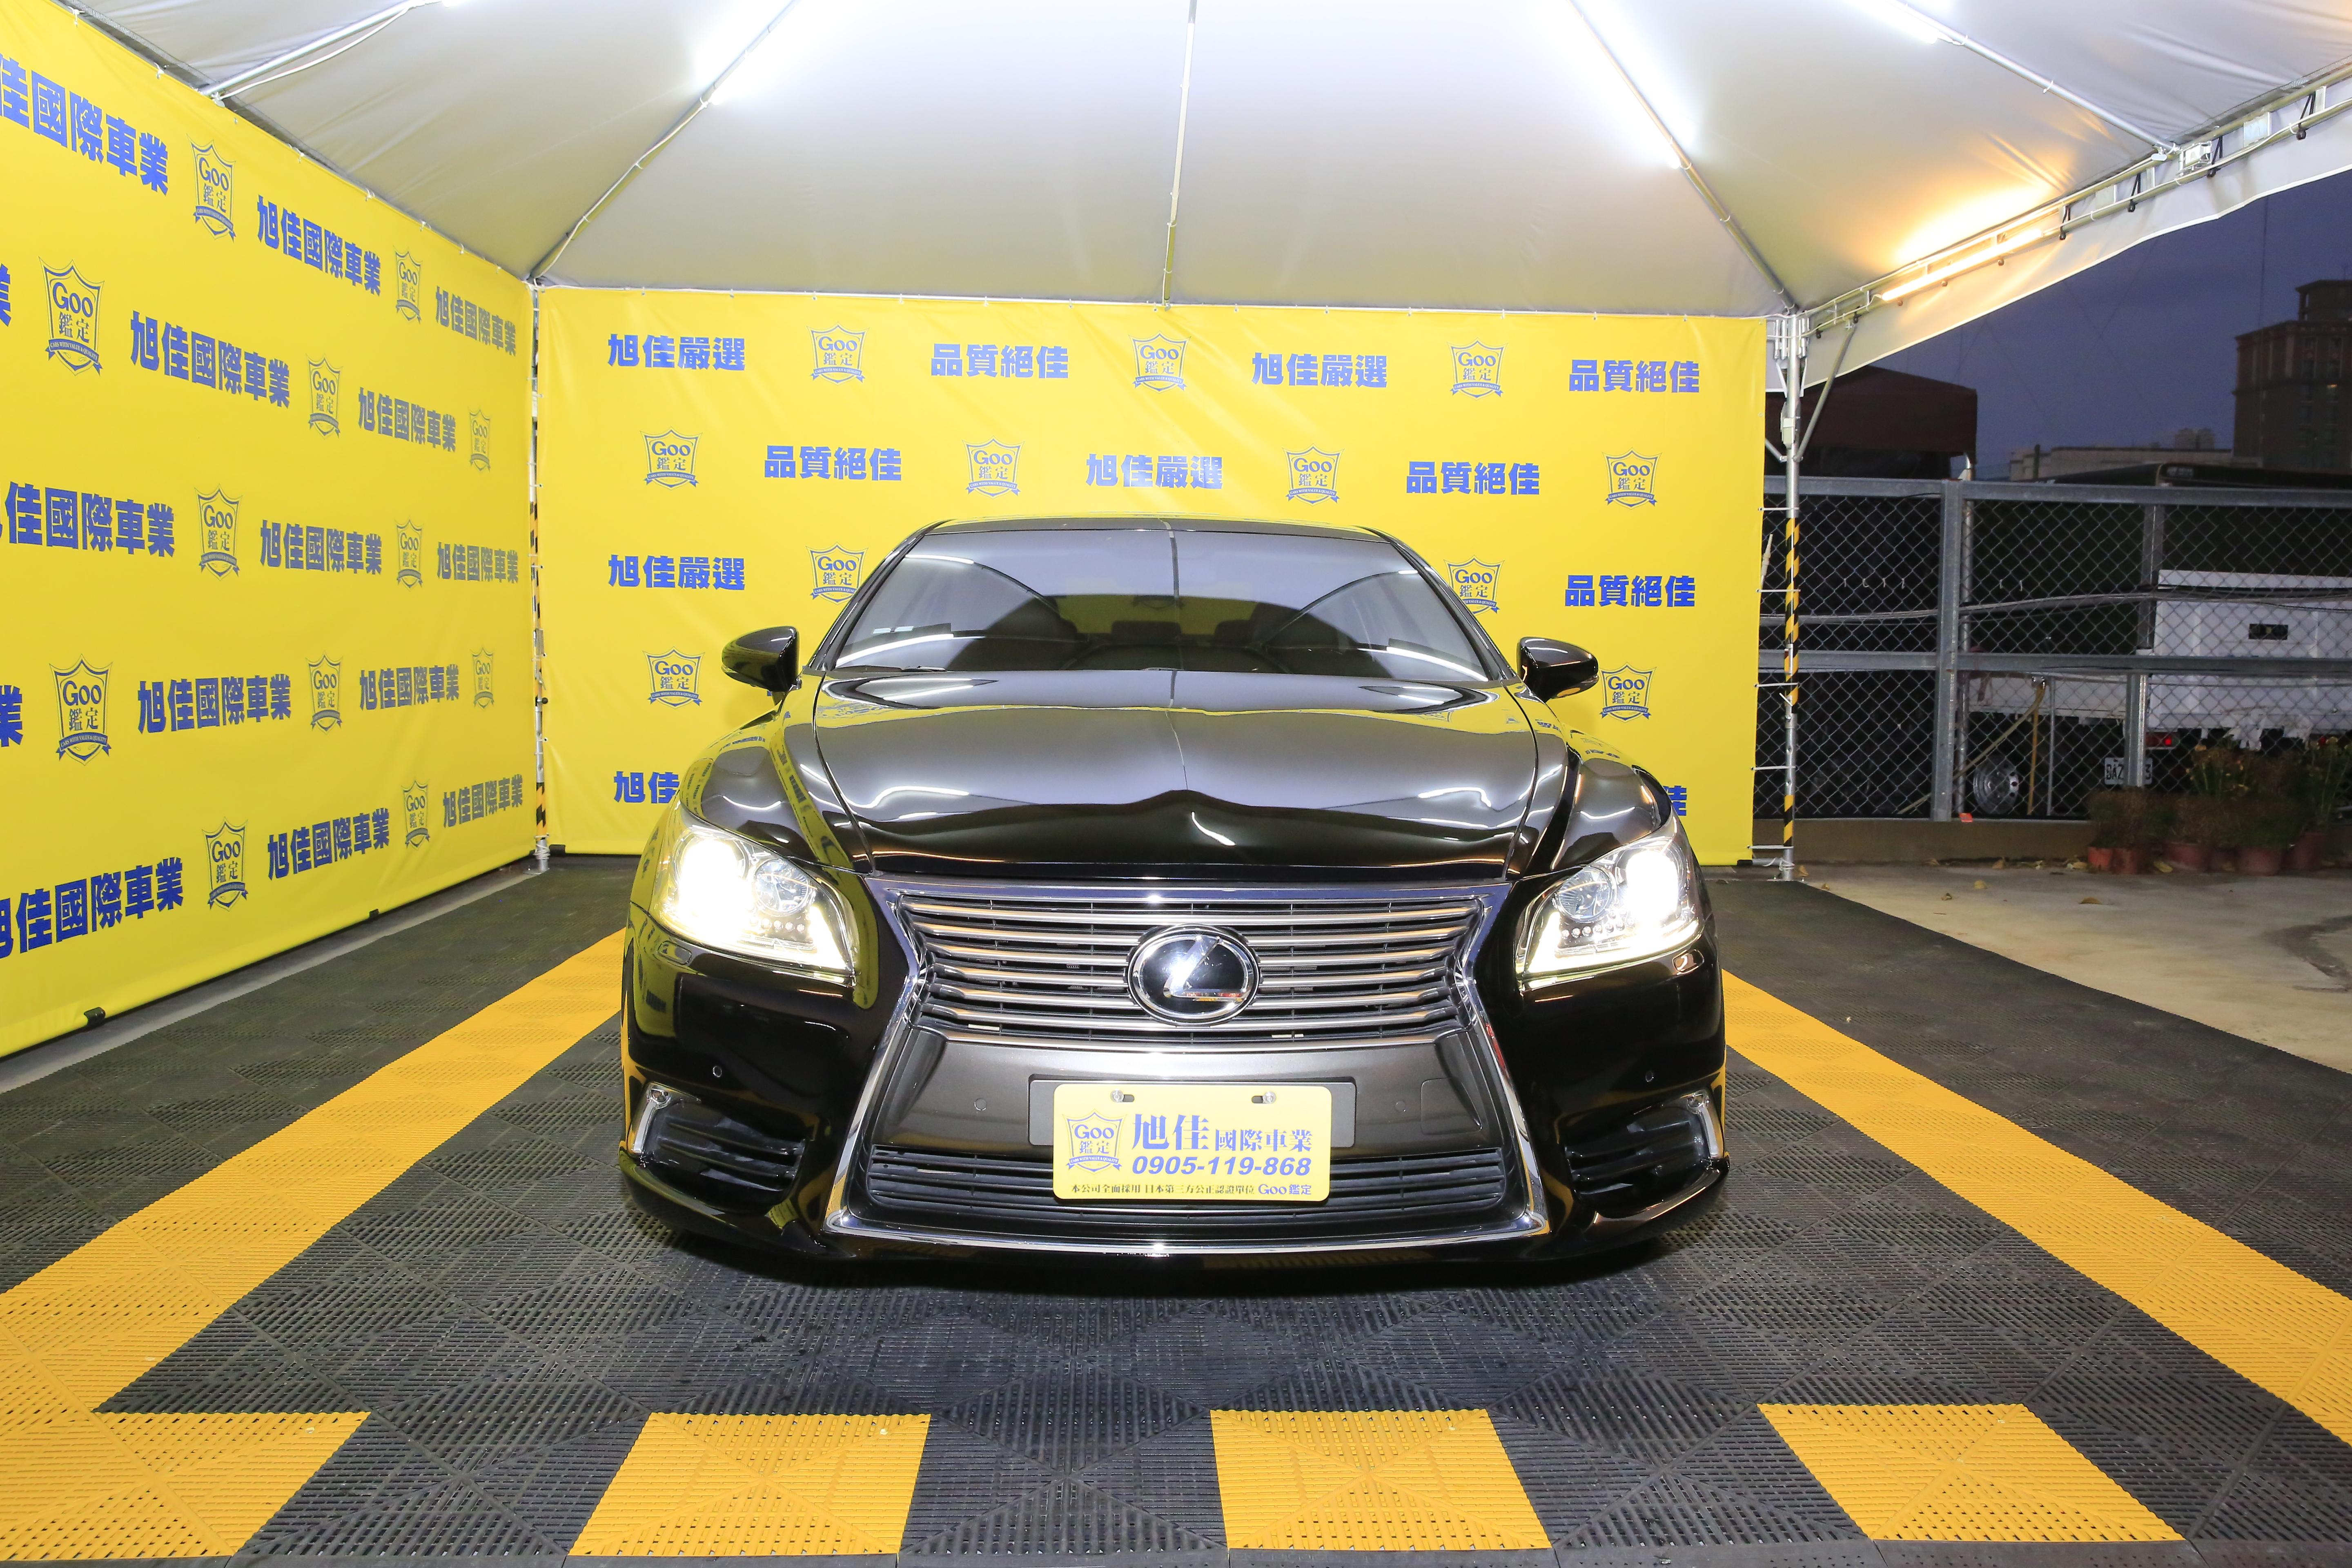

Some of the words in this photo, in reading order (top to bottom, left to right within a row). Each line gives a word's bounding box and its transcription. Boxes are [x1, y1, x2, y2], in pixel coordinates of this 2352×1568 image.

[199, 157, 229, 191] Goo
[203, 183, 226, 212] 鑑定
[257, 195, 381, 296] 旭佳國際車業
[399, 261, 418, 285] Goo
[53, 282, 94, 318] Goo
[58, 312, 89, 343] 鑑定
[436, 286, 517, 356] 旭佳國際車業
[608, 334, 745, 371] 旭佳嚴選
[818, 336, 858, 351] Goo
[1140, 345, 1179, 360] Goo
[131, 310, 290, 408] 旭佳國際車業
[824, 352, 853, 366] 鑑定
[931, 343, 1069, 379] 品質絕佳
[1145, 361, 1175, 374] 鑑定
[1458, 352, 1497, 367] Goo
[1252, 352, 1388, 388] 旭佳嚴選
[1463, 368, 1492, 381] 鑑定
[1569, 359, 1699, 393] 品質絕佳
[313, 371, 336, 395] Goo
[358, 387, 456, 452] 旭佳國際車業
[652, 441, 691, 456] Goo
[973, 450, 1013, 465] Goo
[657, 457, 686, 470] 鑑定
[765, 445, 902, 481] 品質絕佳
[979, 466, 1008, 479] 鑑定
[1086, 453, 1223, 490] 旭佳嚴選
[1294, 457, 1332, 472] Goo
[1613, 462, 1650, 477] Goo
[1299, 473, 1328, 487] 鑑定
[1407, 461, 1539, 495] 品質絕佳
[1618, 477, 1646, 490] 鑑定
[204, 505, 233, 529] Goo
[208, 530, 229, 551] 鑑定
[261, 520, 381, 574] 旭佳國際車業
[401, 532, 419, 550] Goo
[437, 542, 518, 584] 旭佳國際車業
[608, 555, 745, 590] 旭佳嚴選
[818, 556, 857, 571] Goo
[823, 572, 853, 586] 鑑定
[1455, 569, 1493, 584] Goo
[1460, 585, 1488, 598] 鑑定
[1565, 575, 1695, 607] 品質絕佳
[655, 661, 694, 675] Goo
[314, 670, 337, 689] Goo
[360, 665, 459, 710] 旭佳國際車業
[660, 677, 690, 690] 鑑定
[1608, 676, 1645, 690] Goo
[63, 680, 102, 706] Goo
[138, 674, 291, 733] 旭佳國際車業
[1613, 691, 1641, 704] 鑑定
[69, 707, 99, 731] 鑑定
[406, 795, 425, 811] Goo
[443, 774, 523, 827] 旭佳國際車業
[212, 841, 241, 862] Goo
[267, 808, 390, 880] 旭佳國際車業
[216, 861, 238, 883] 鑑定
[1074, 1124, 1115, 1139] Goo
[1080, 1140, 1110, 1154] 鑑定
[1132, 1156, 1312, 1176] 0905-119-868
[1258, 1184, 1287, 1195] Goo
